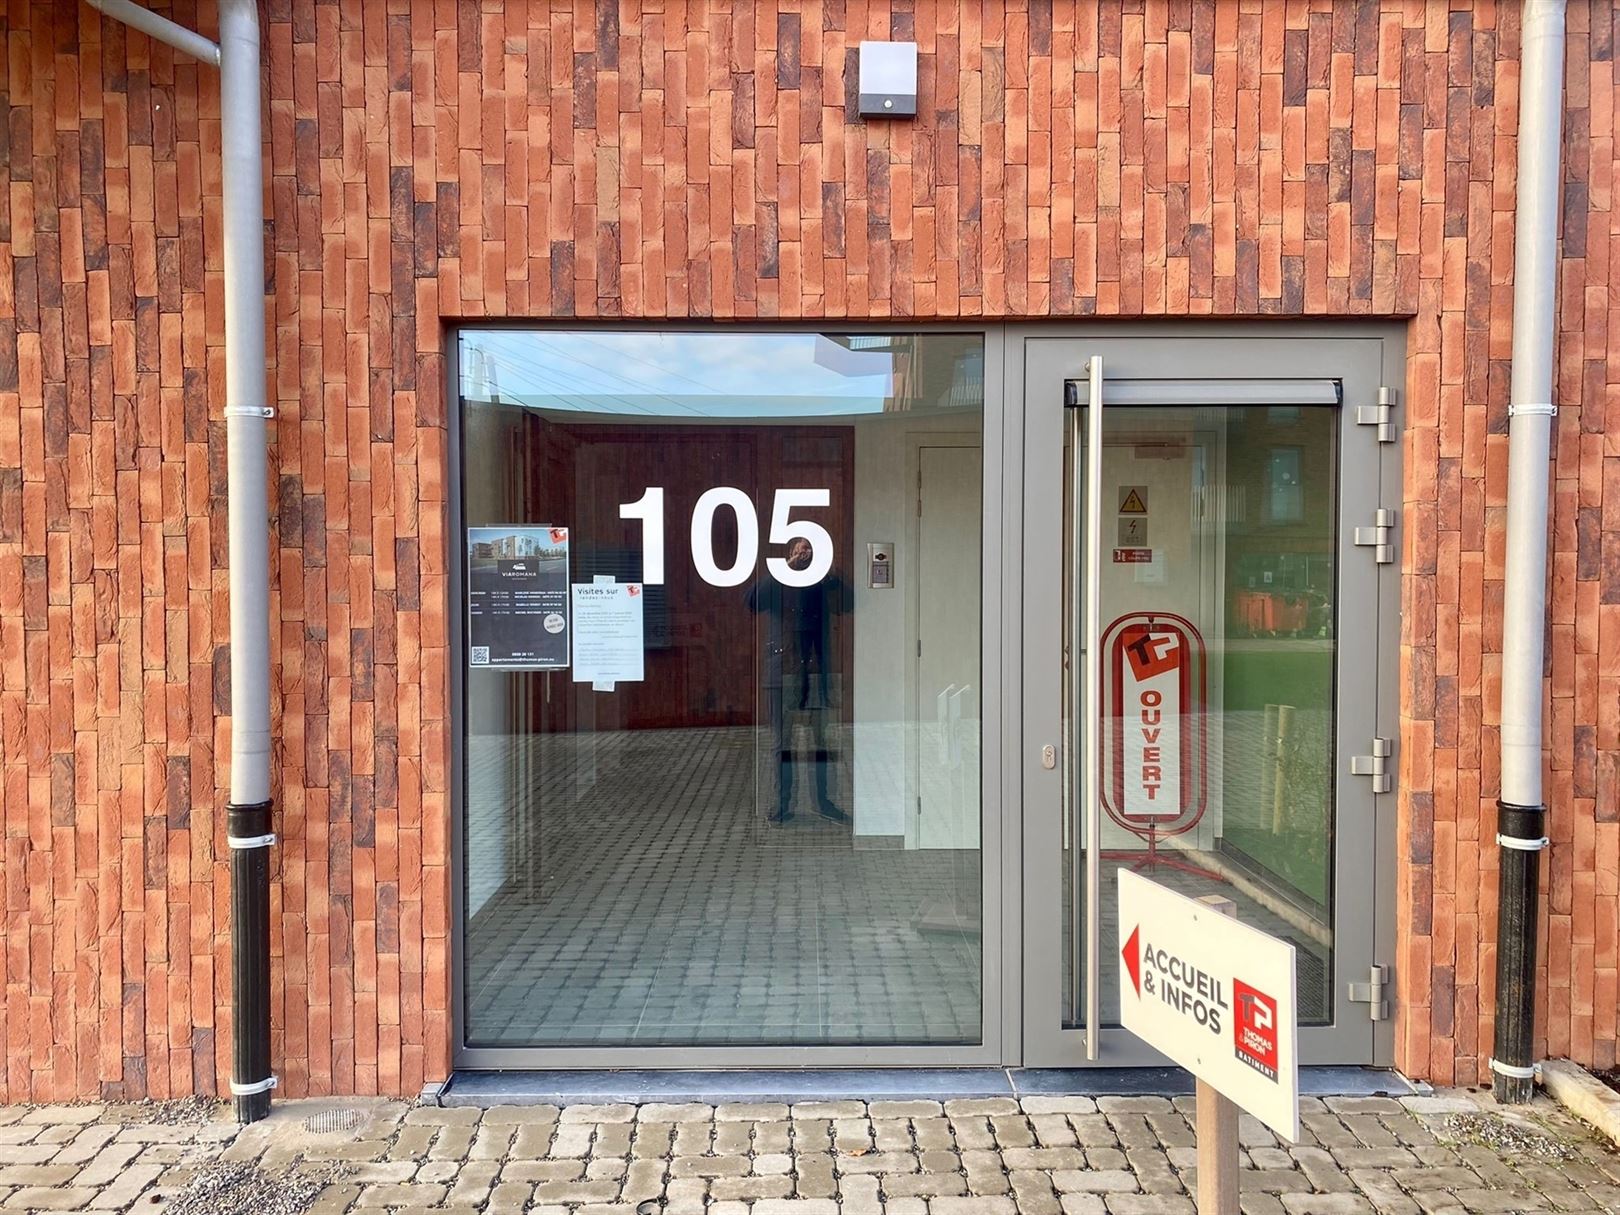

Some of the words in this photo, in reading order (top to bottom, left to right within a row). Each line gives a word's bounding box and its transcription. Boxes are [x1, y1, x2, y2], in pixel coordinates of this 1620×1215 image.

[619, 487, 834, 588] 105
[1140, 690, 1162, 801] OUVERT
[1143, 943, 1229, 1010] ACCUEIL
[1144, 970, 1156, 996] &
[1161, 978, 1223, 1036] INFOS
[1243, 1026, 1273, 1050] THOMAS
[1243, 1037, 1266, 1056] PIRON
